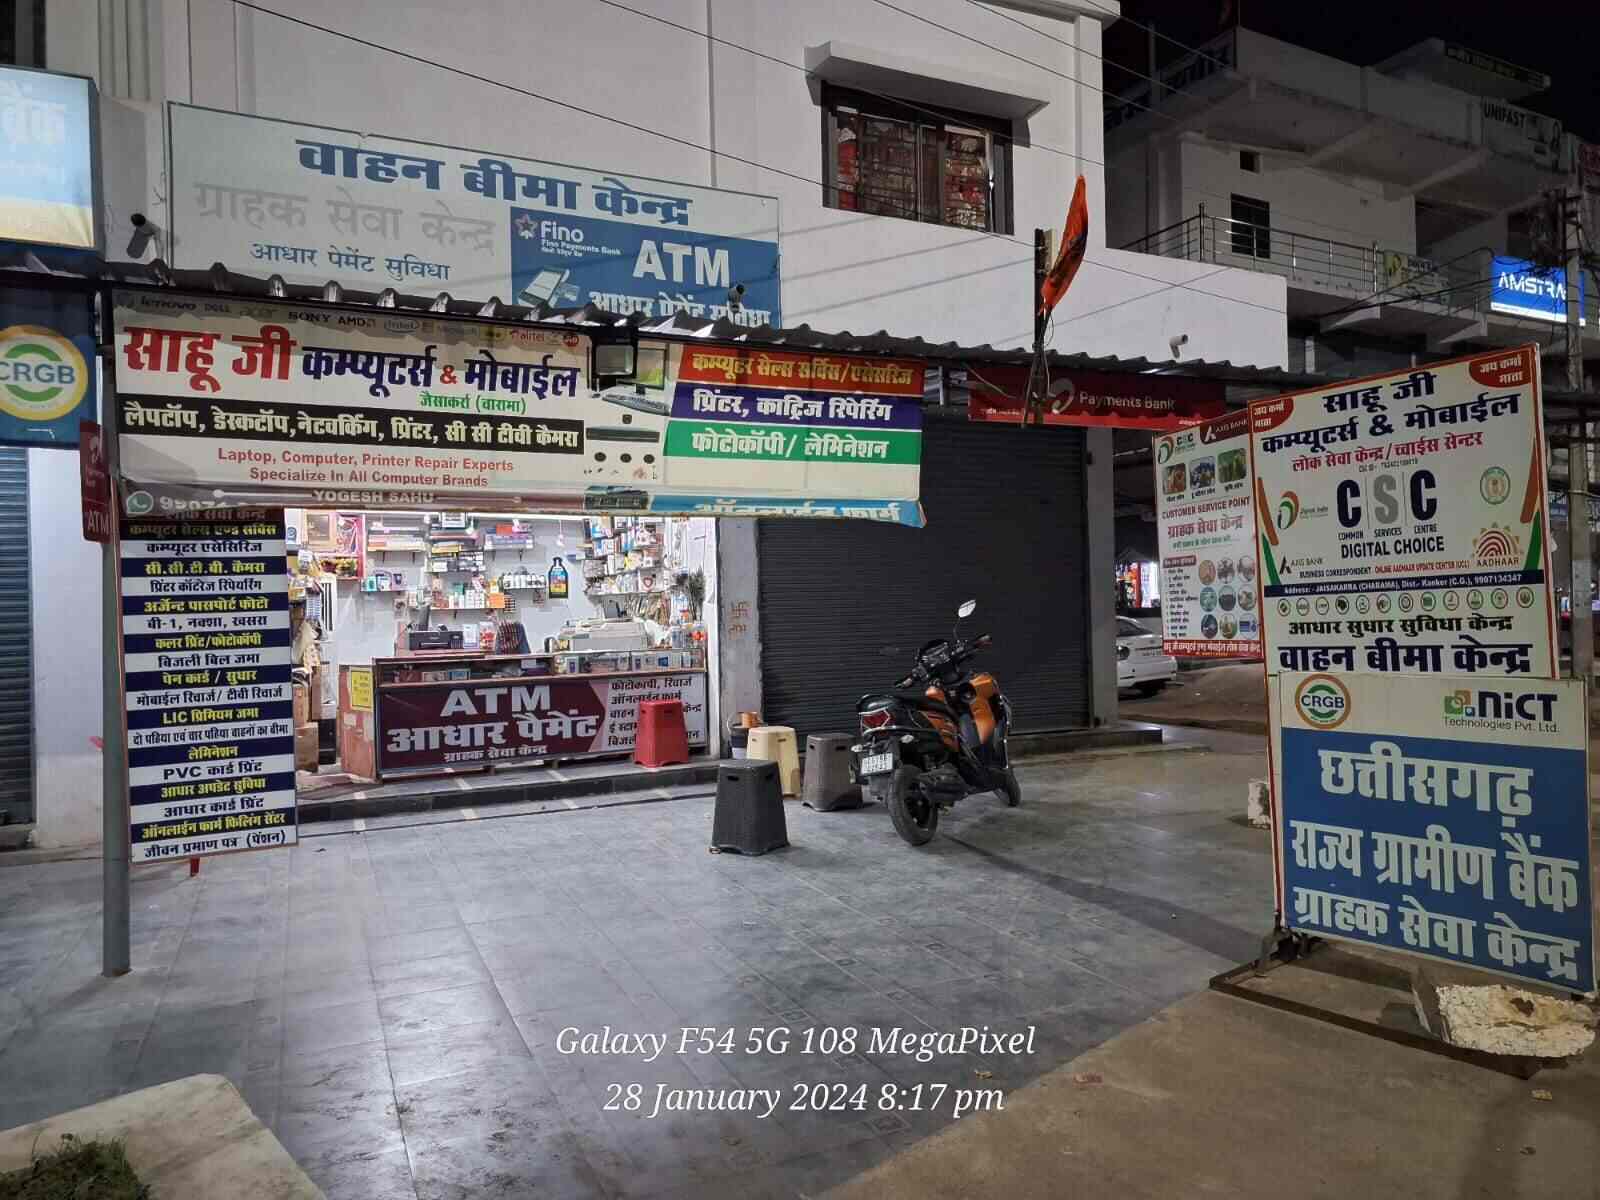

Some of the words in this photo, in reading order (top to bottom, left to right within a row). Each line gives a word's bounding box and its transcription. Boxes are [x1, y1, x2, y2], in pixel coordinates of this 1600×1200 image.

[295, 139, 446, 190] वाहन
[459, 158, 581, 210] बीमा
[592, 176, 693, 226] केन्द्र
[194, 182, 308, 229] ग्राहक
[325, 185, 403, 240] सेवा
[541, 220, 584, 242] Fino
[250, 242, 319, 267] आधार
[328, 245, 375, 272] पेमेंट
[384, 253, 451, 282] सुविधा
[633, 239, 731, 287] ATM
[288, 311, 331, 323] SONY
[338, 316, 366, 328] AMD
[123, 326, 222, 393] साहू
[231, 324, 297, 381] जी
[301, 345, 437, 398] कम्प्यूटर्स
[439, 364, 457, 385] &
[463, 350, 581, 400] मोबाईल
[692, 388, 749, 418] प्रिंटर,
[1079, 391, 1141, 409] Payments
[1323, 384, 1386, 413] साहू
[1390, 371, 1437, 399] जी
[1261, 416, 1359, 453] कम्प्यूटर्स
[1369, 414, 1394, 437] &
[1403, 392, 1522, 429] मोबाईल
[535, 423, 580, 449] कैमरा
[804, 432, 889, 459] लेमिनेशन
[218, 447, 276, 465] Laptop,
[281, 450, 358, 468] Computer,
[362, 454, 411, 467] Printer
[415, 455, 459, 472] Repair
[463, 457, 514, 473] Experts
[1292, 454, 1322, 472] लोक
[1325, 448, 1351, 468] सेवा
[1445, 431, 1484, 451] सेन्टर
[249, 467, 327, 482] Specialize
[330, 470, 345, 482] In
[348, 470, 367, 483] All
[371, 471, 441, 487] Computer
[443, 473, 489, 488] Brands
[312, 489, 383, 503] YOGESH
[1198, 500, 1228, 513] SERVICE
[1228, 495, 1250, 508] POINT
[1337, 469, 1438, 528] CSC
[87, 510, 111, 536] ATM
[1338, 531, 1364, 541] COMMON
[1374, 527, 1402, 538] SERVICES
[1414, 523, 1438, 534] CENTRE
[1341, 540, 1391, 559] DIGITAL
[1394, 536, 1445, 555] CHOICE
[1476, 557, 1519, 568] AADHAAR
[1288, 619, 1341, 636] आधार
[1346, 616, 1397, 638] सुधार
[1400, 614, 1463, 637] सुविधा
[1467, 612, 1514, 633] केन्द्र
[234, 653, 260, 666] जमा
[1278, 645, 1356, 672] वाहन
[1365, 637, 1444, 673] बीमा
[1451, 634, 1533, 674] केन्द्र
[440, 685, 551, 716] ATM
[1300, 692, 1345, 710] CRGB
[163, 710, 188, 725] LIC
[1444, 717, 1512, 731] Technologies
[1514, 719, 1536, 732] Pvt.
[1538, 721, 1560, 733] Ltd.
[387, 721, 508, 752] आधार
[163, 766, 202, 780] PVC
[1317, 740, 1534, 828] छत्तीसगढ़
[164, 804, 206, 818] आधार
[1289, 819, 1364, 877] राज्य
[1371, 824, 1497, 900] ग्रामीण
[1500, 832, 1580, 913] बैंक
[1293, 886, 1390, 936] ग्राहक
[1398, 894, 1477, 958] सेवा
[1484, 911, 1581, 981] केन्द्र
